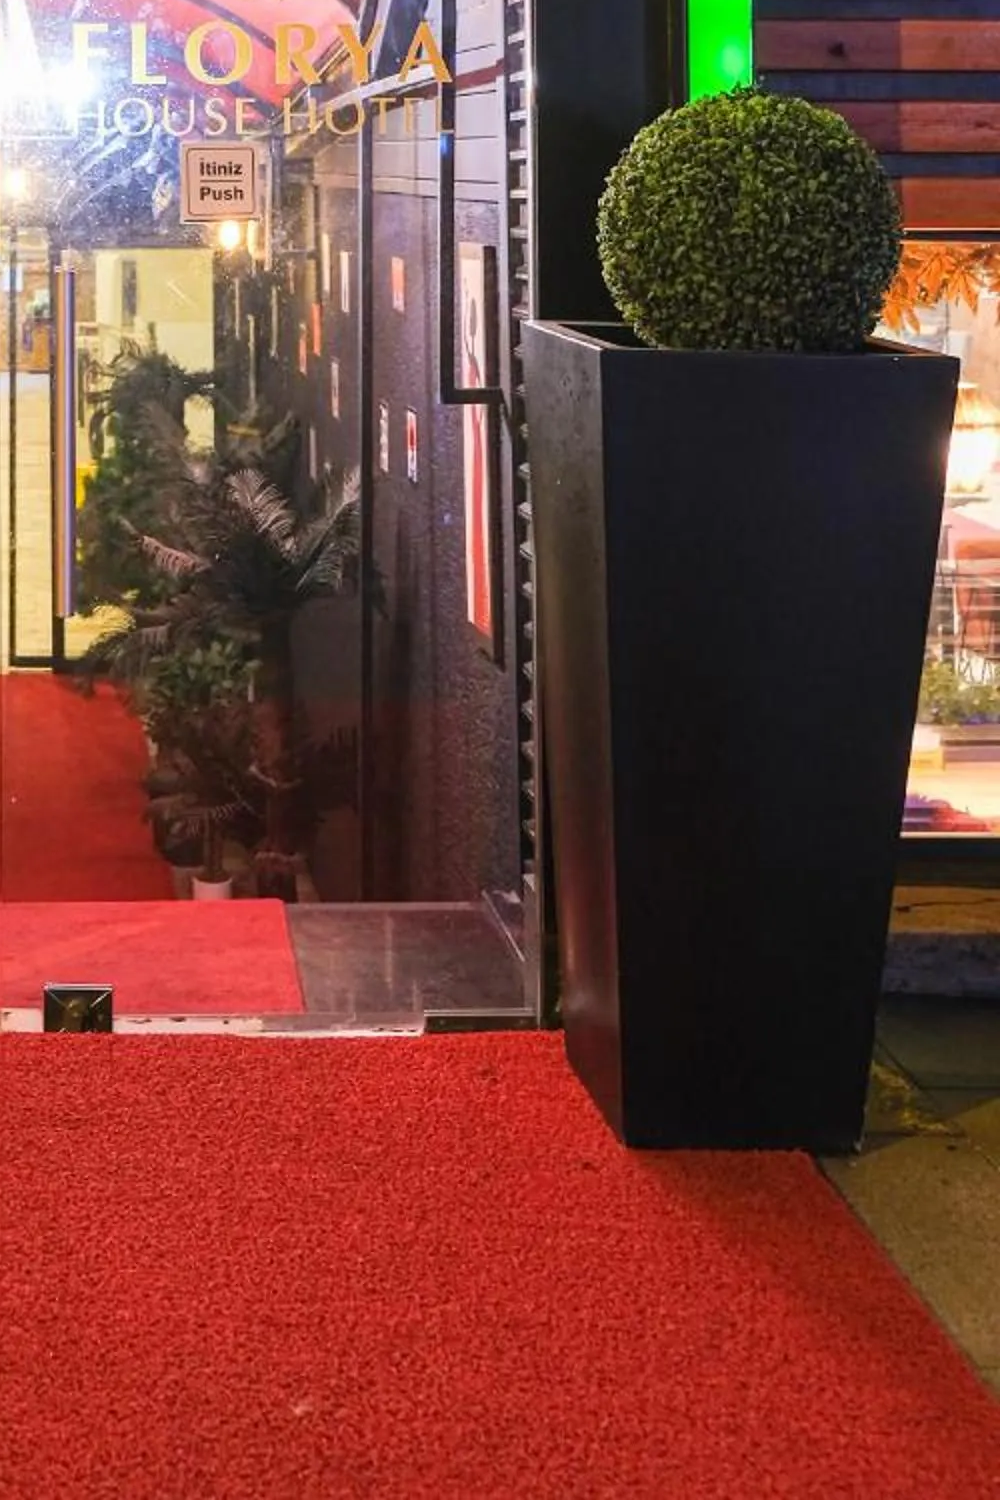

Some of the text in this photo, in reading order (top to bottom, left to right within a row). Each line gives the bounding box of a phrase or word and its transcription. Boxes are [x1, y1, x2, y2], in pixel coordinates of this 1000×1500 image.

[71, 20, 453, 86] FLORYA
[72, 96, 258, 136] HOUSE
[199, 186, 245, 201] Push
